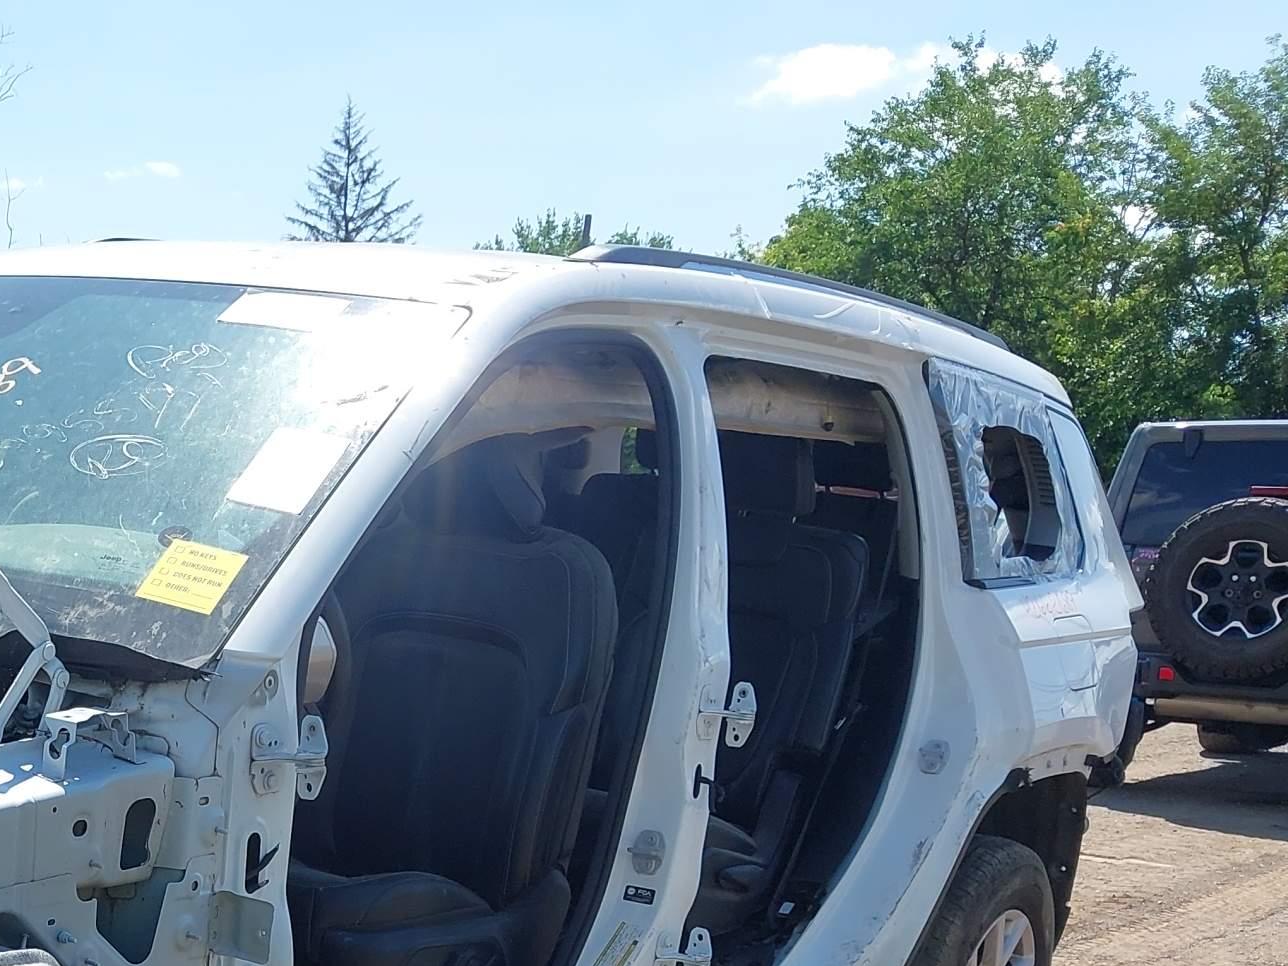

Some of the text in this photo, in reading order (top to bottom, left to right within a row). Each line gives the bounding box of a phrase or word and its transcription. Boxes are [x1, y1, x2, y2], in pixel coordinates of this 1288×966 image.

[200, 552, 217, 561] KEYS
[181, 560, 228, 577] RUNS/DRIVES
[172, 571, 223, 588] DOES NOT RUN
